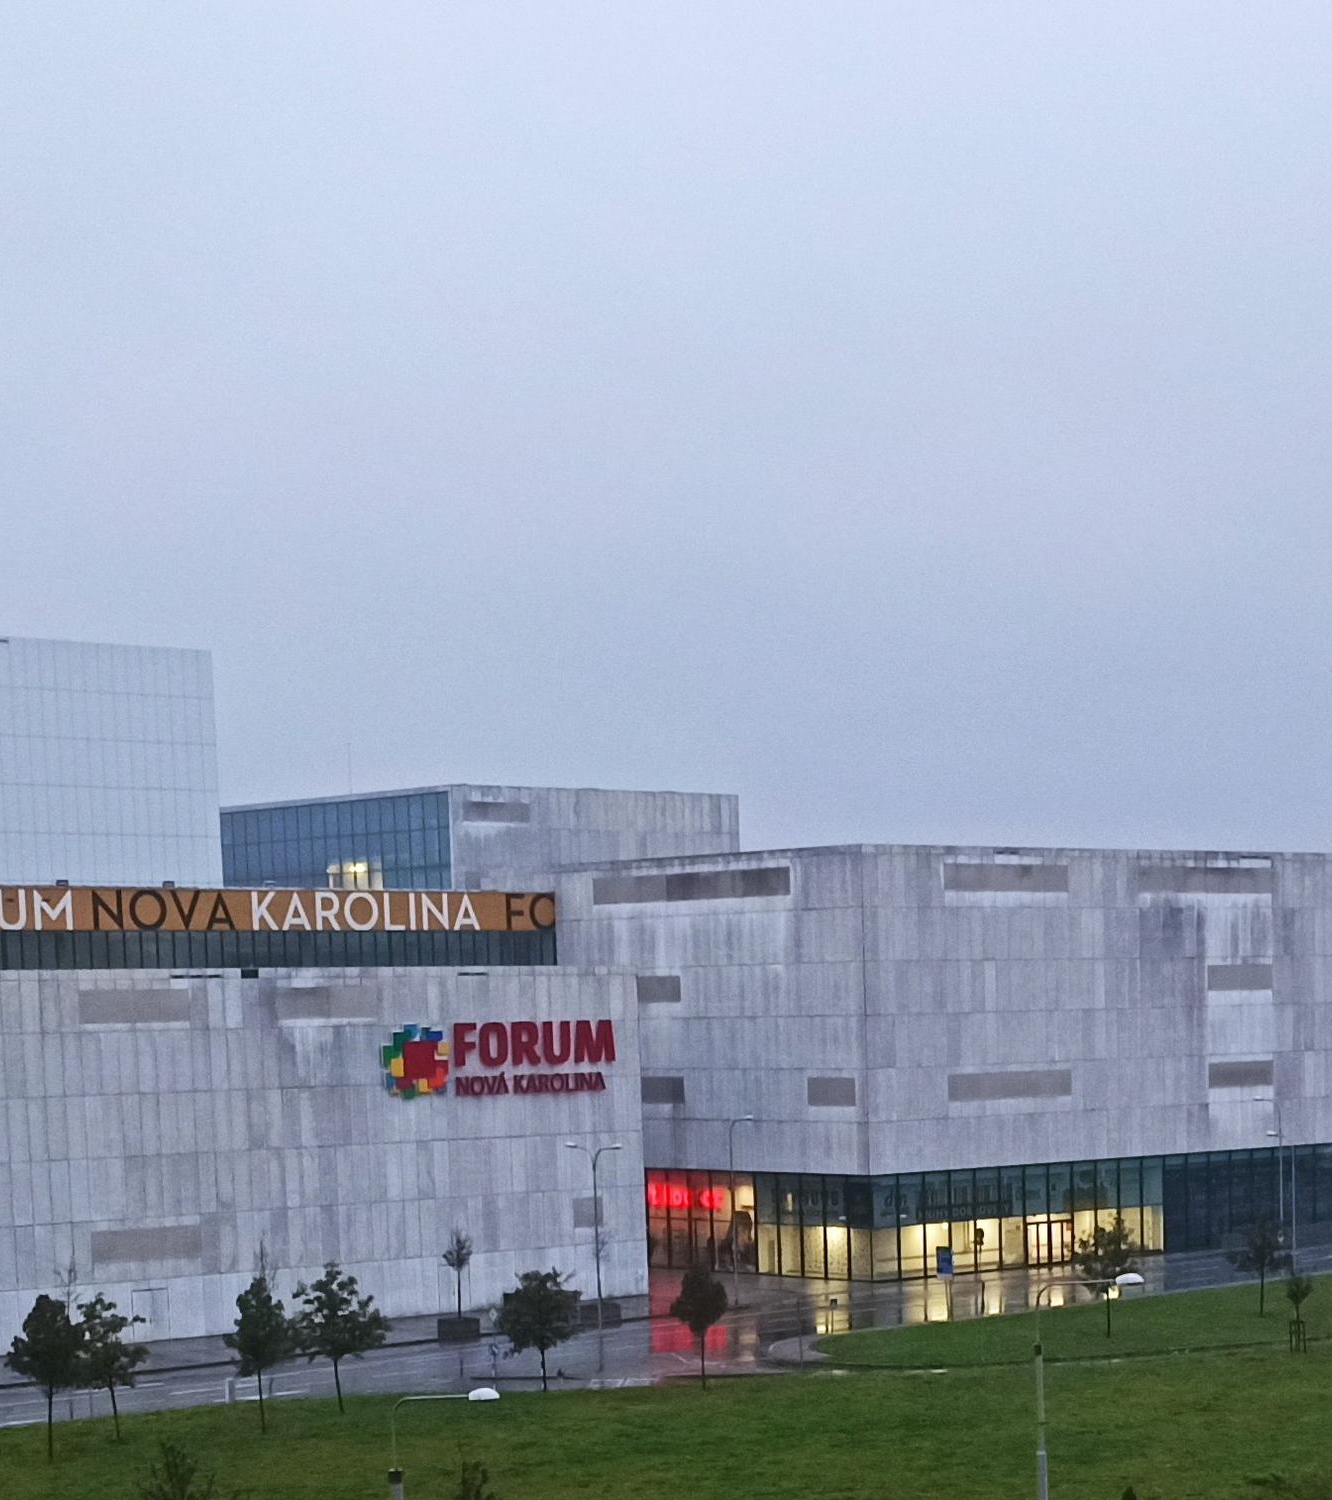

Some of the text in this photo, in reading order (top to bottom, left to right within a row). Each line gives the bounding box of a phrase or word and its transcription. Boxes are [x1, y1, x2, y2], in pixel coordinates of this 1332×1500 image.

[93, 889, 235, 931] NOVA
[251, 890, 481, 932] KAROLINA
[453, 1019, 616, 1068] FORUM
[455, 1071, 607, 1097] NOVÁ KAROLINA
